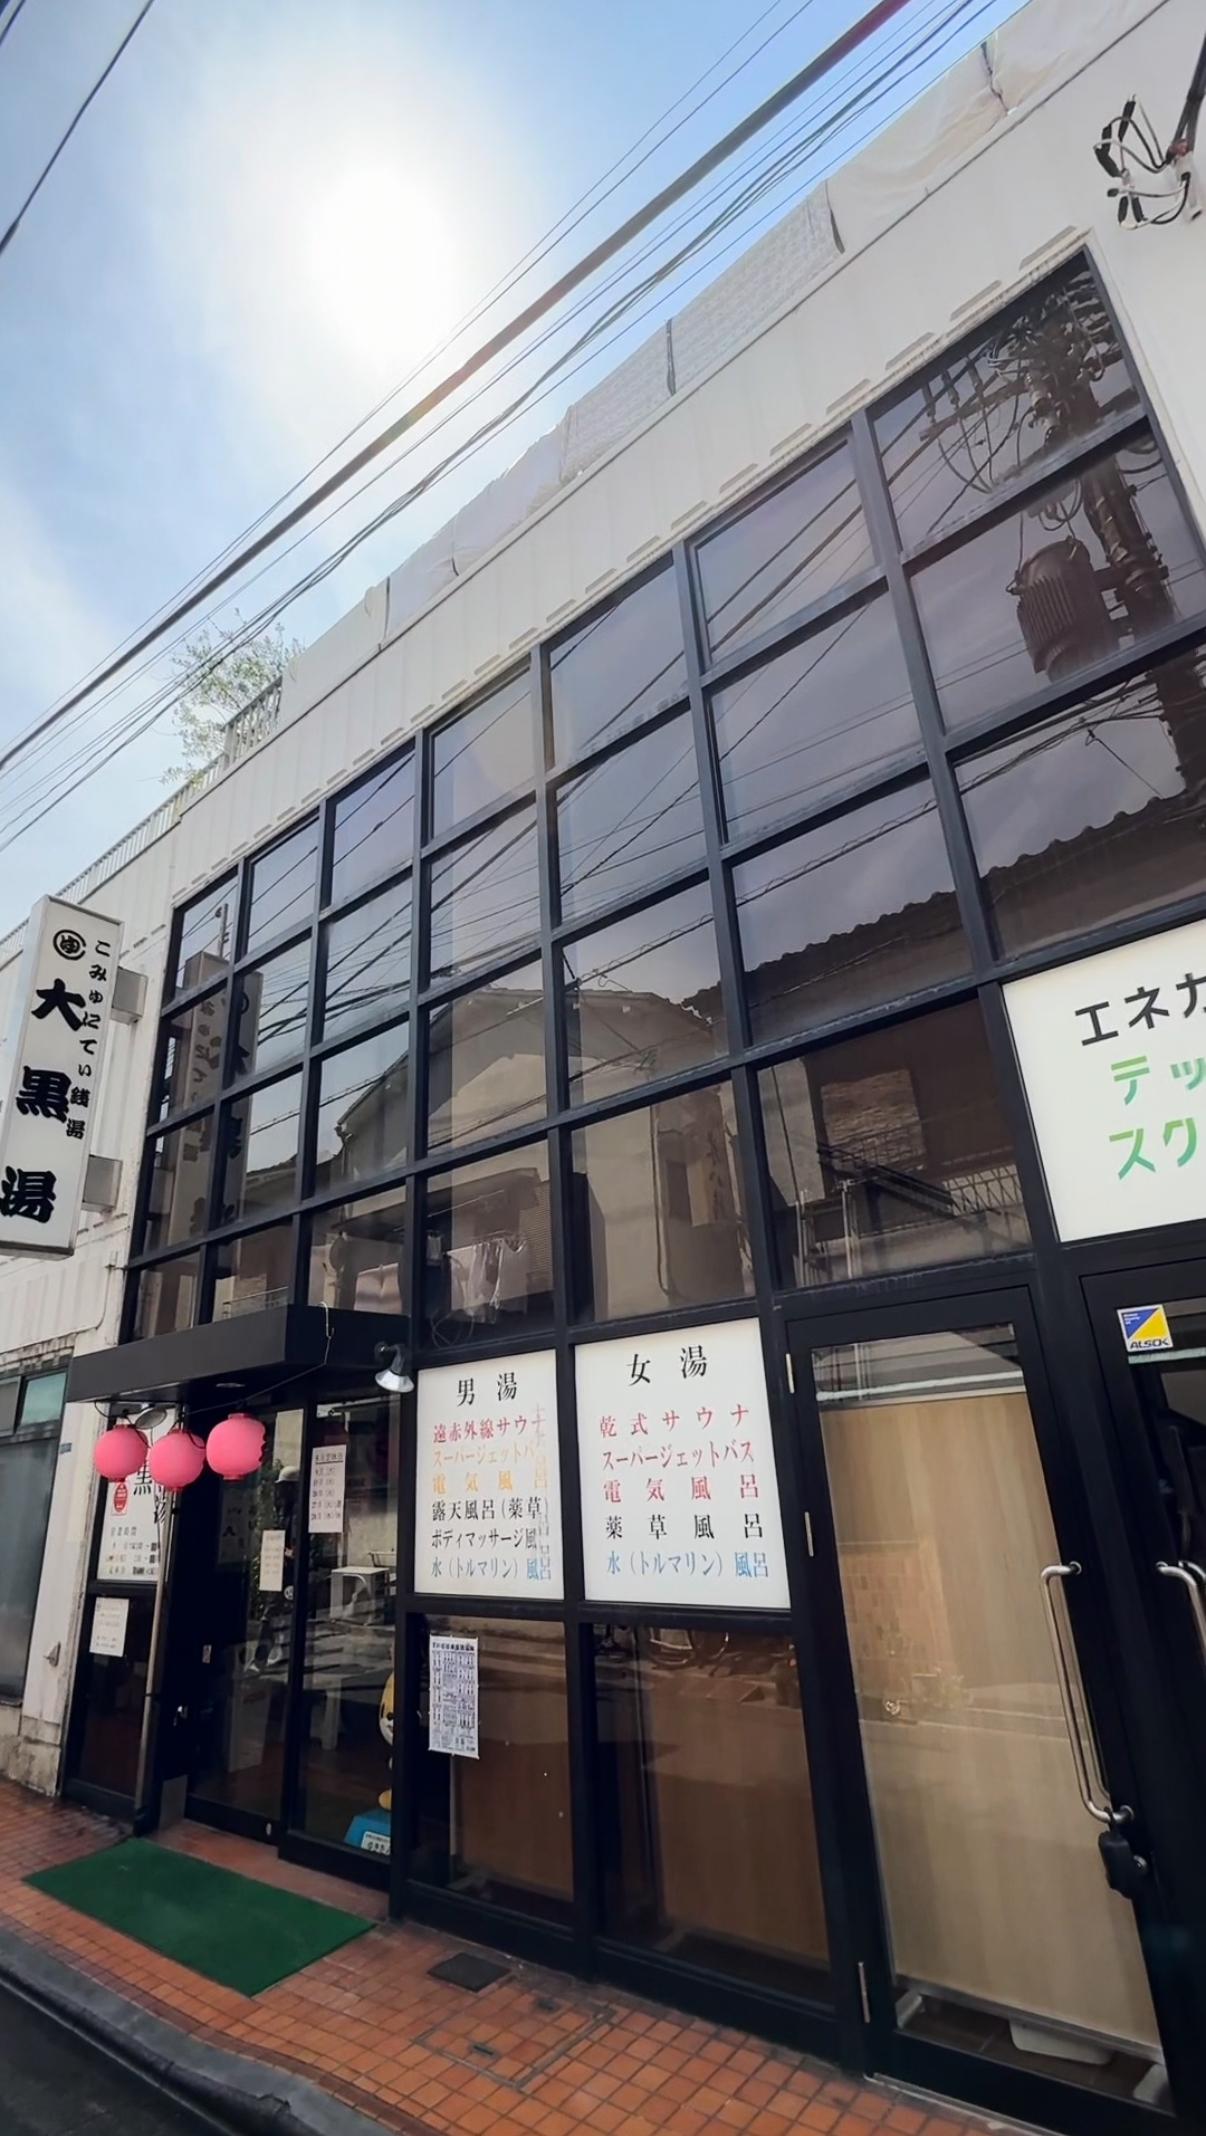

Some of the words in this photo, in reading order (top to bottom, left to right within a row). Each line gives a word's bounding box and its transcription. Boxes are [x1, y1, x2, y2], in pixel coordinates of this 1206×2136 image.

[0, 977, 86, 1224] 大黒湯
[1108, 1116, 1198, 1181] スク
[1130, 1337, 1170, 1349] ALSOK
[626, 1344, 709, 1387] 女湯
[456, 1371, 518, 1408] 男湯
[599, 1403, 750, 1439] 乾式サウナ
[602, 1438, 755, 1471] スーパージェットバス
[602, 1473, 760, 1504] 電気風呂
[604, 1512, 764, 1541] 薬草風呂
